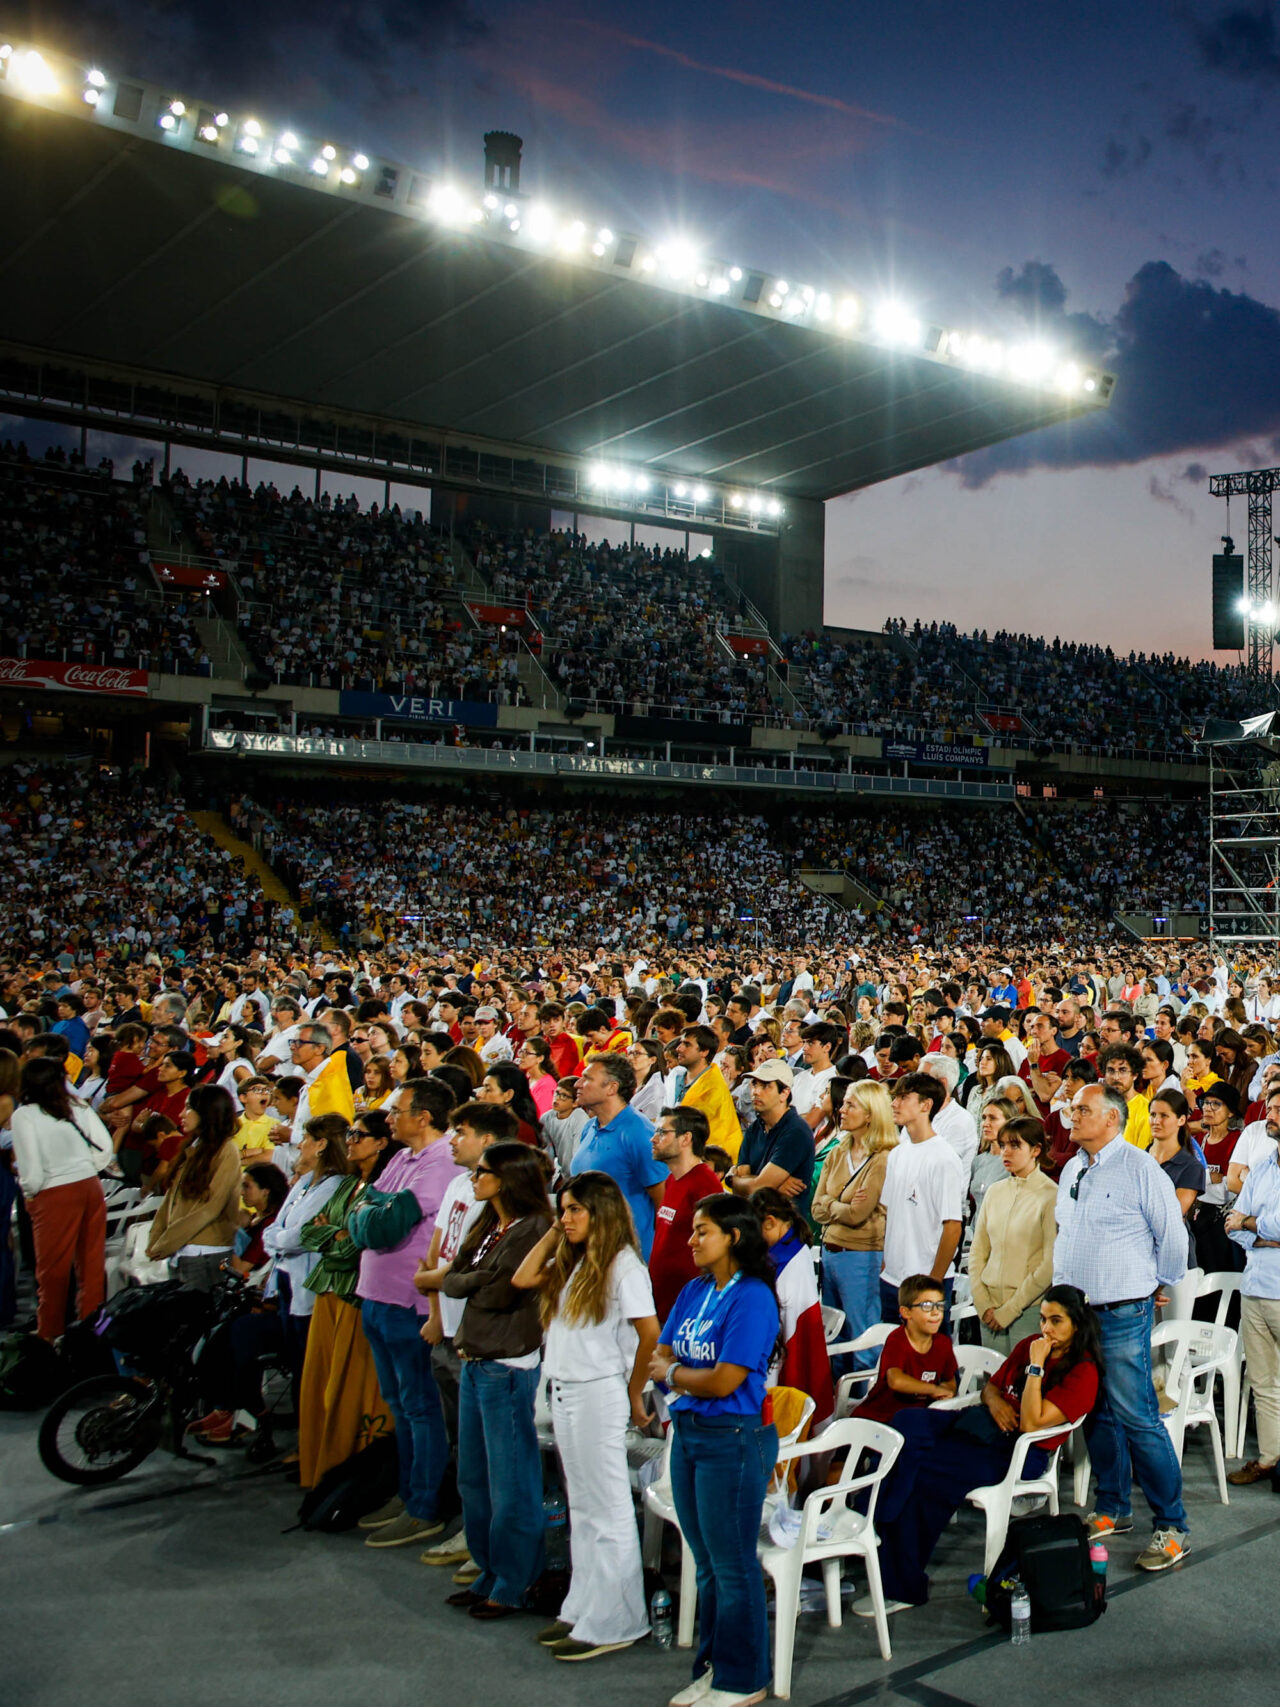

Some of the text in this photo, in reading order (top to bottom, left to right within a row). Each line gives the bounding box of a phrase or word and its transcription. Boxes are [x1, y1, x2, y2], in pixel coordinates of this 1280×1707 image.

[64, 665, 136, 689] Coca-Cola
[389, 695, 455, 716] VERI
[922, 752, 943, 761] LLUÍS
[945, 754, 984, 764] COMPANYS
[925, 744, 982, 756] ESTADI OLÍMPIC
